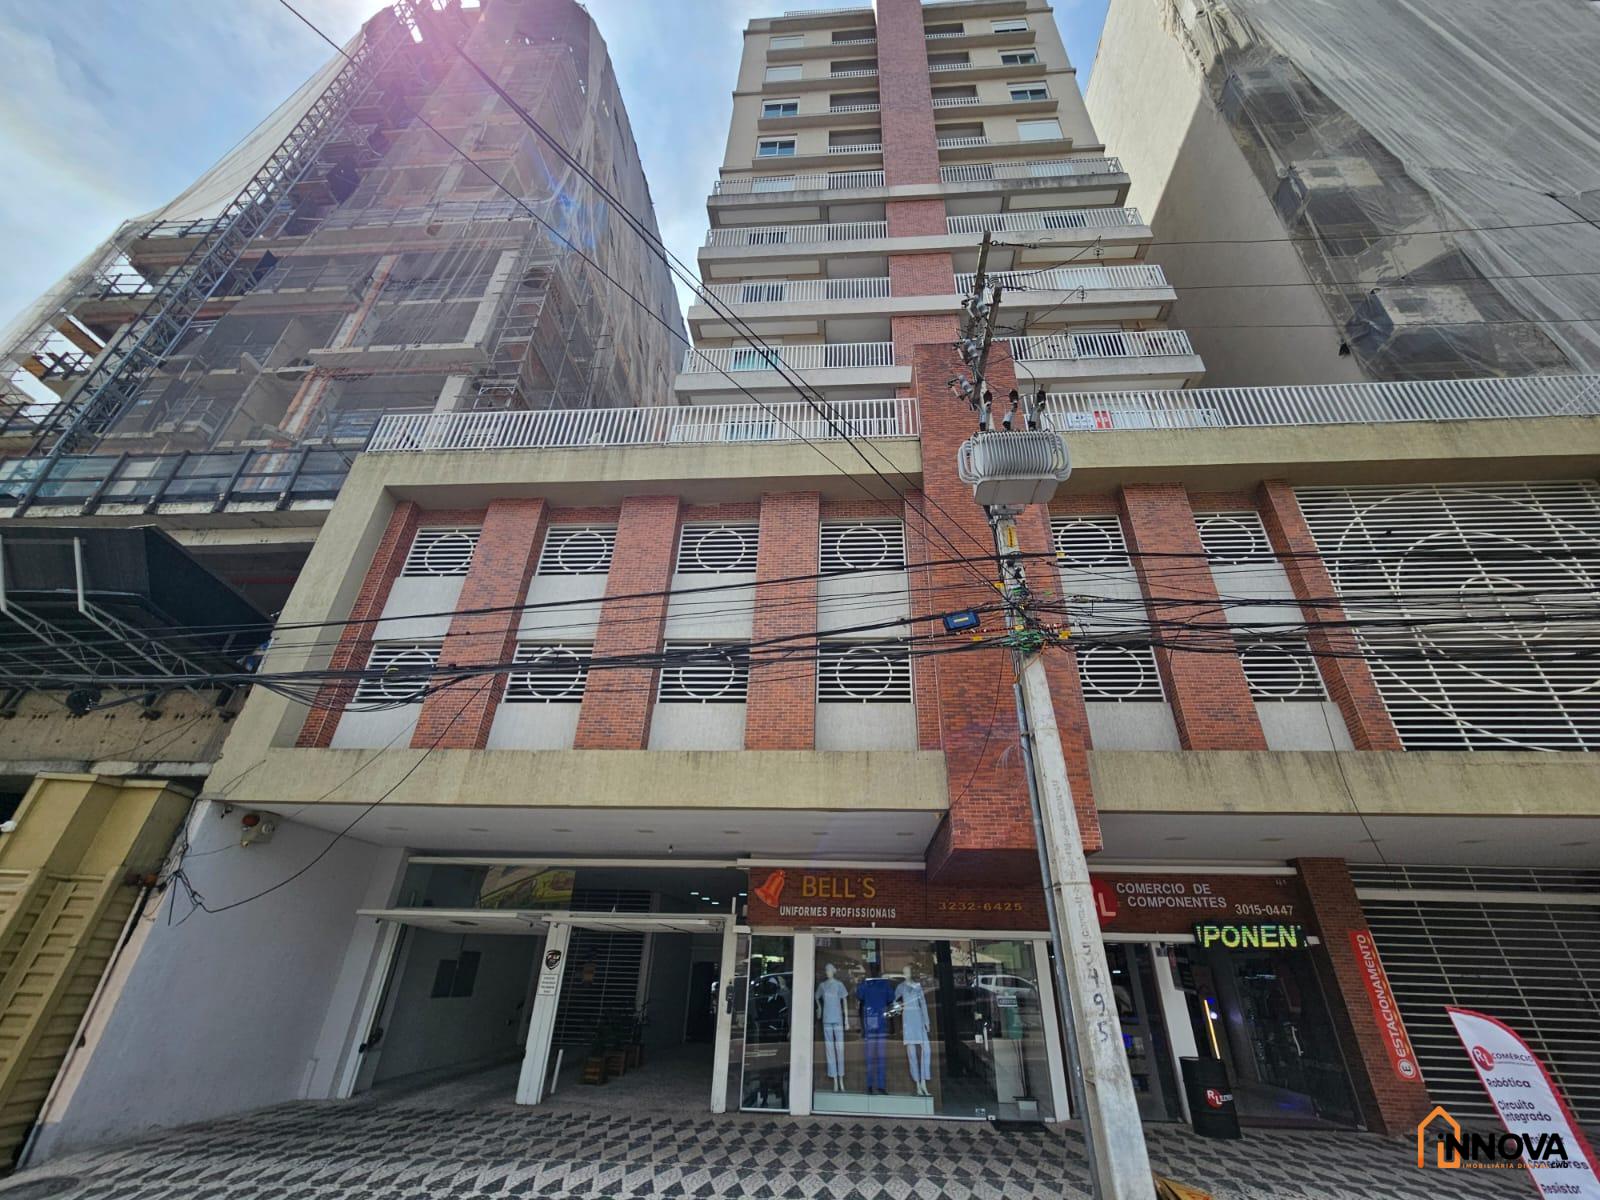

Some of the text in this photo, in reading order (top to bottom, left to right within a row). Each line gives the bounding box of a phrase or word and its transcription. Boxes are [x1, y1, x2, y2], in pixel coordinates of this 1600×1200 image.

[1116, 882, 1212, 894] COMERCIO DE
[939, 902, 1023, 911] 3232-6425
[1127, 896, 1227, 908] COMPONENTES
[780, 906, 896, 919] UNIFORMES PROFISSIONAIS
[1235, 903, 1293, 916] 3015-0447
[1196, 925, 1302, 948] PONEN
[1357, 934, 1406, 1058] ESTACIONAMENTO
[1498, 1100, 1535, 1110] Circuito
